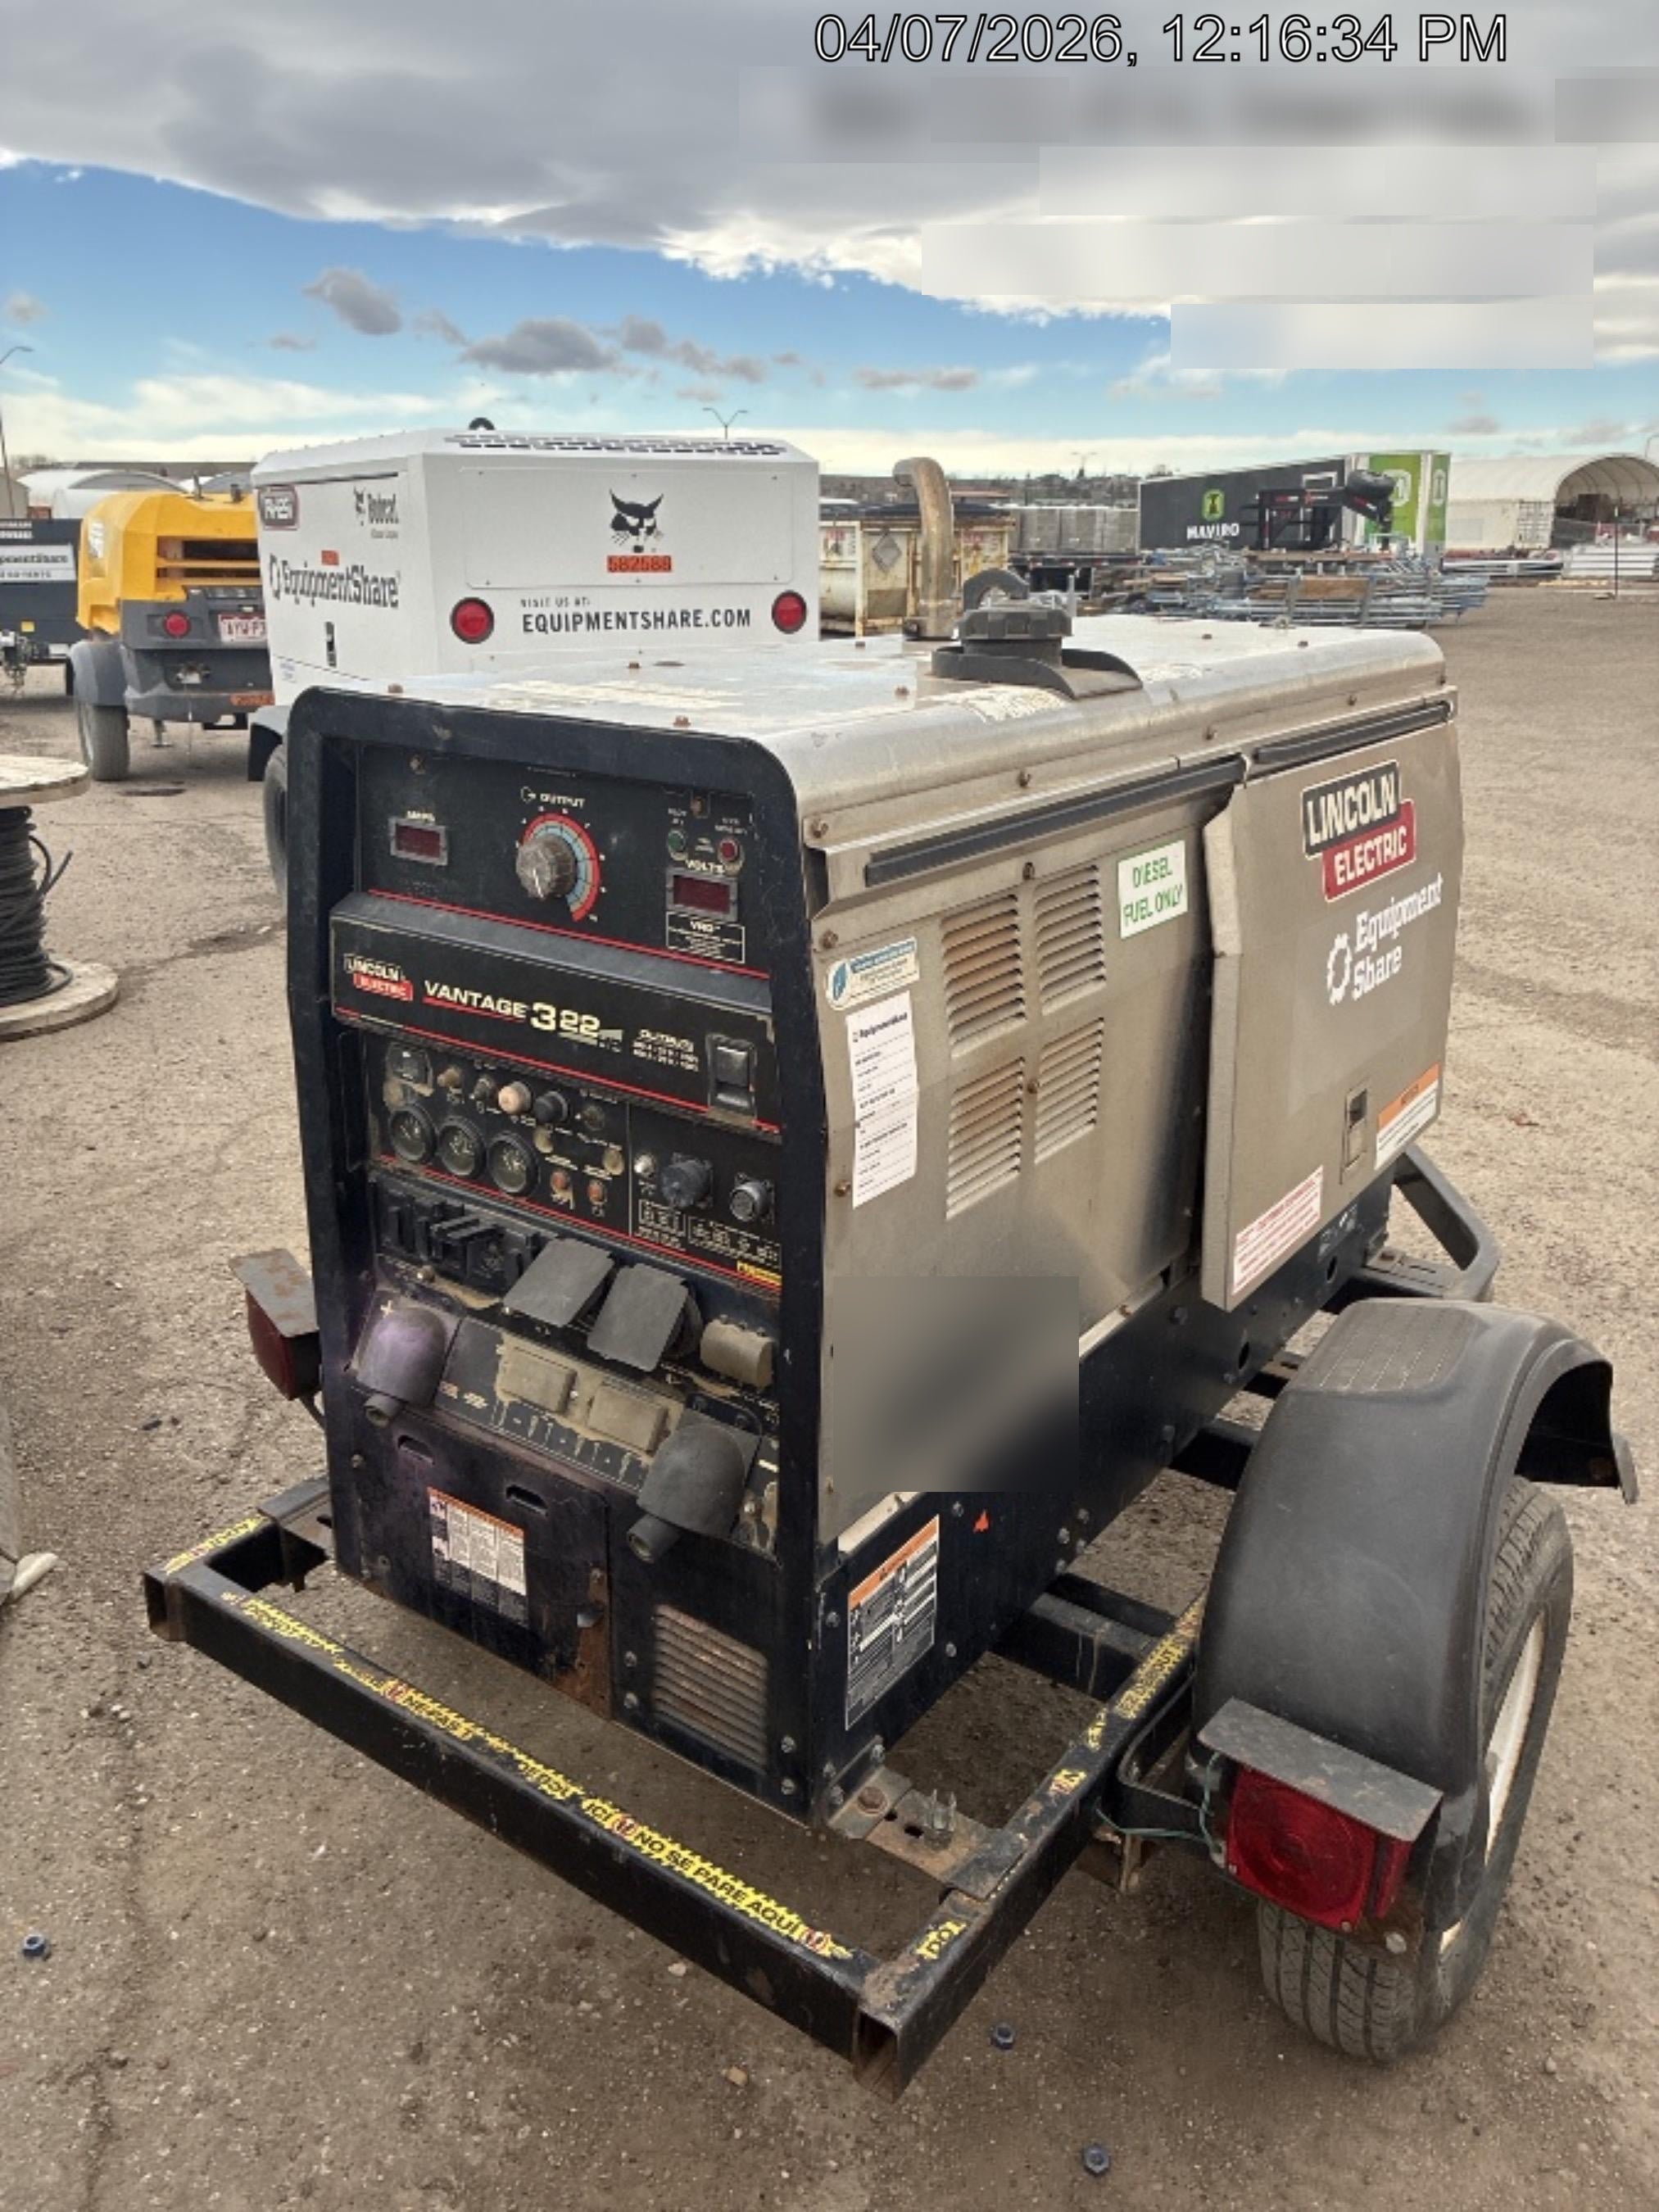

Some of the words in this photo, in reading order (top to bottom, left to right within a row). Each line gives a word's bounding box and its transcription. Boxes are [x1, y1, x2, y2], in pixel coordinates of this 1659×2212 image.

[1186, 522, 1240, 541] MAVIRO
[282, 560, 399, 608] EquipmentShare
[555, 597, 569, 608] US
[523, 609, 751, 634] EQUIPMENTSHARE.COM
[1307, 772, 1398, 846] LINCOLN
[1133, 856, 1172, 888] DIESEL
[1334, 825, 1407, 886] ELECTRIC
[1123, 898, 1153, 927] FUEL
[1155, 883, 1183, 913] ONLY
[1355, 872, 1444, 955] Equipment
[347, 955, 399, 981] LINCOLN
[1353, 946, 1403, 1001] Share
[424, 980, 527, 1018] VANTAGE
[530, 1001, 601, 1038] 322
[633, 1831, 666, 1852] NO
[693, 1866, 747, 1902] PARE
